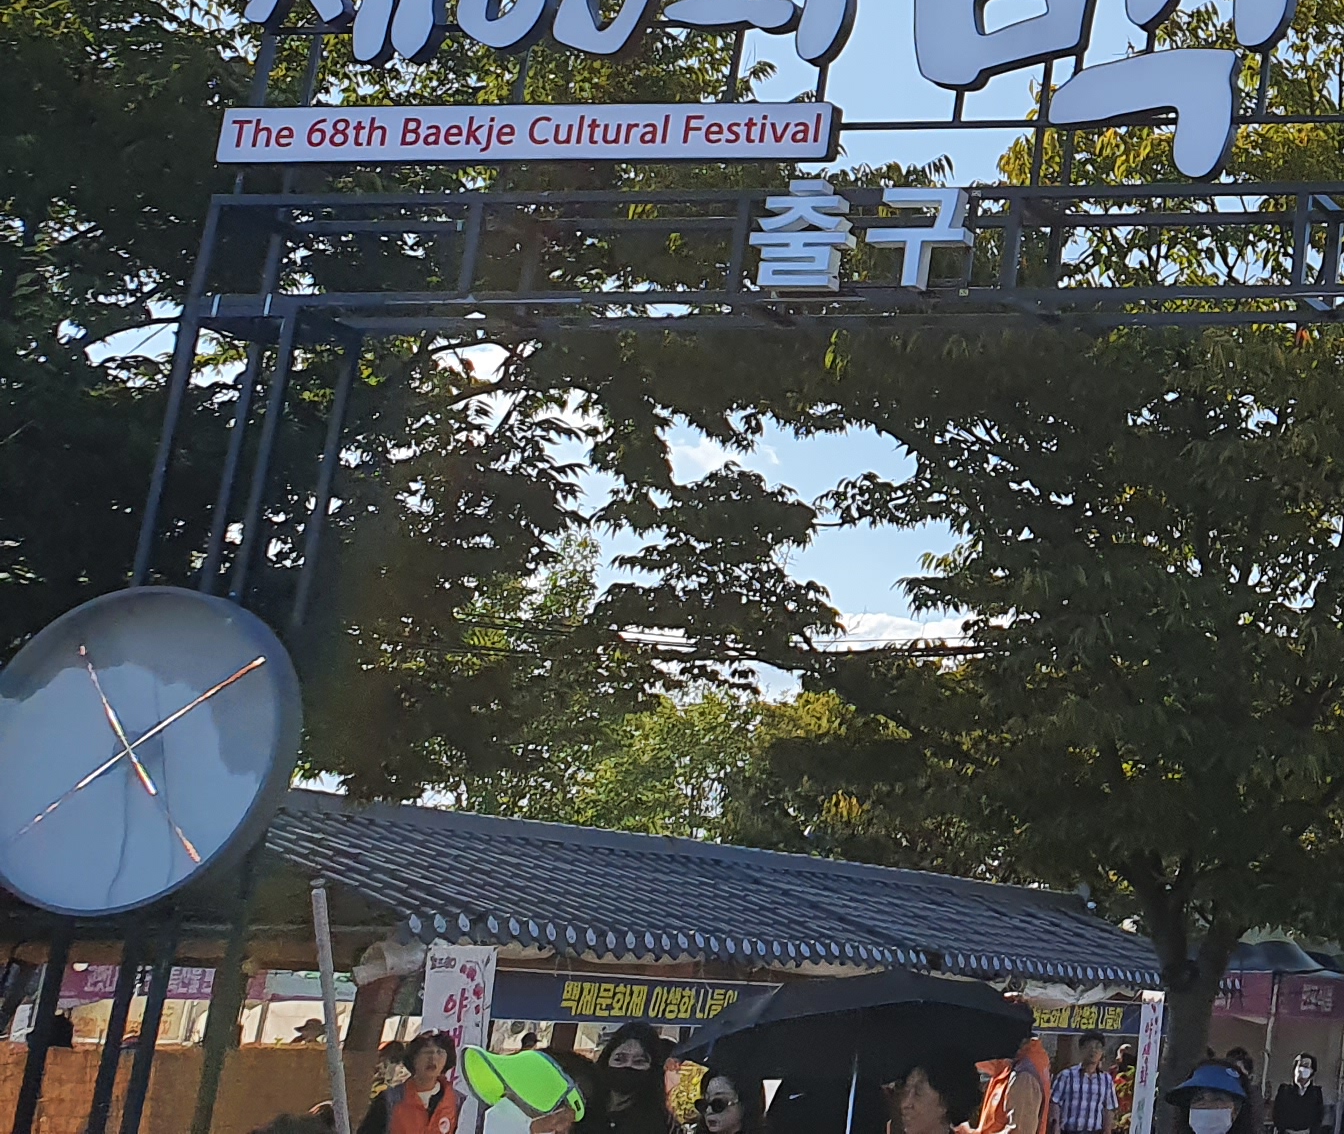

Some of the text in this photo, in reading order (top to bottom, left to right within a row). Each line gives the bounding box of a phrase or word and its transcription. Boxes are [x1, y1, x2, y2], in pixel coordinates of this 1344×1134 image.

[231, 111, 825, 153] The 68th Baekje Cultural Festival
[748, 177, 975, 293] 출구
[561, 981, 648, 1016] 백제문화제
[649, 986, 696, 1019] 야생화
